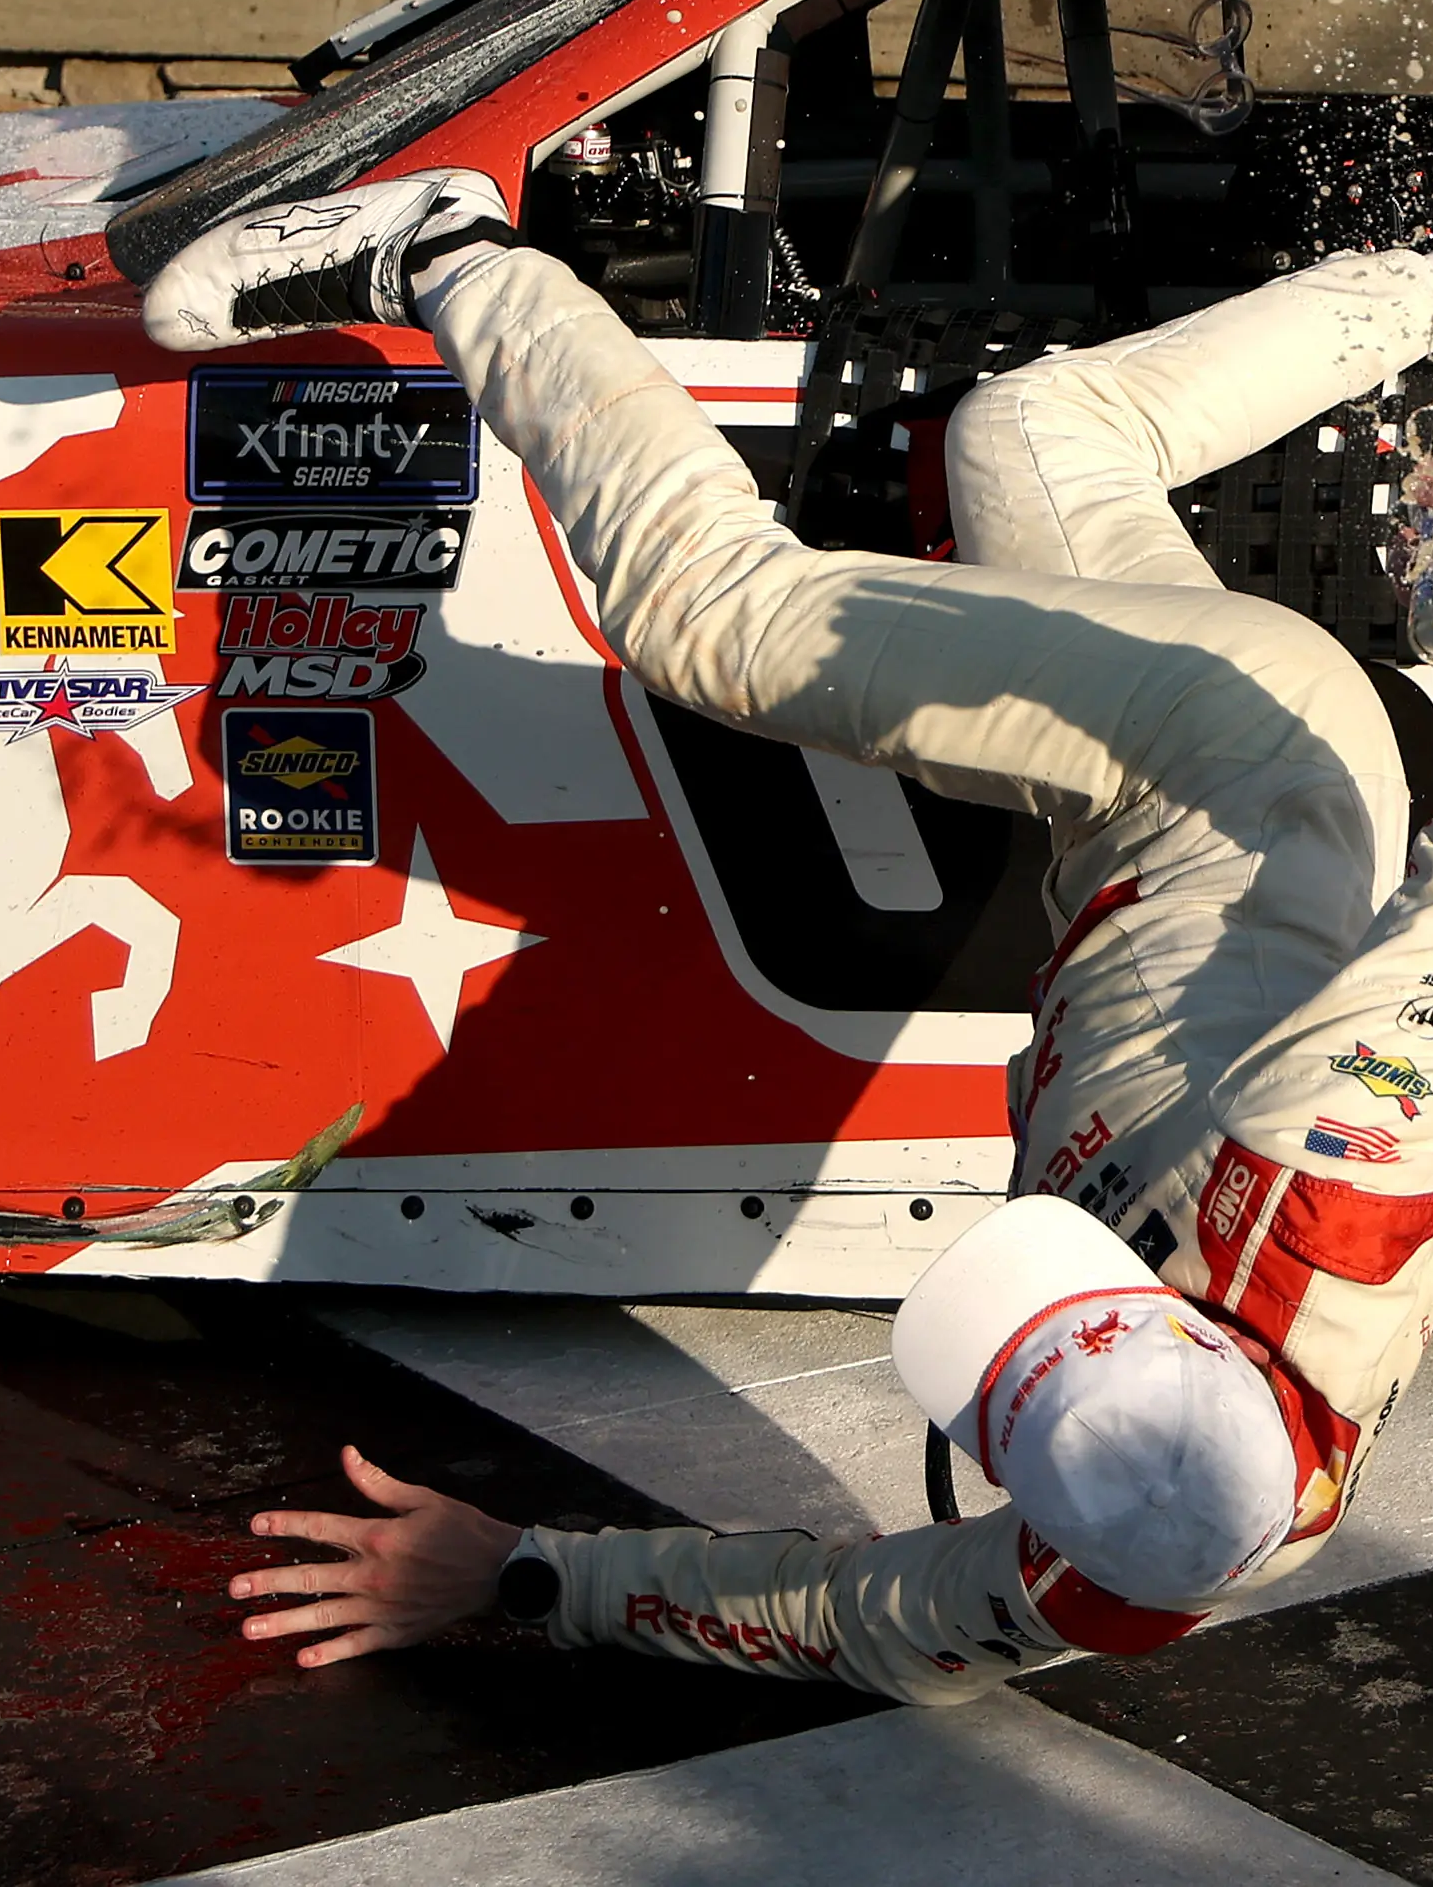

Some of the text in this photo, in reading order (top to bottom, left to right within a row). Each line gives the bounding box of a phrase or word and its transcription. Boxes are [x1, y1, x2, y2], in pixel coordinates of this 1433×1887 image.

[302, 381, 399, 405] NASCAR
[236, 409, 431, 474] xfinity
[291, 465, 371, 489] SERIES
[189, 514, 461, 575] COMETIC
[206, 574, 310, 587] GASKET
[4, 624, 169, 650] KENNAMETAL
[221, 596, 427, 662] Holley
[63, 676, 151, 702] STAR
[217, 654, 390, 698] MSD
[81, 705, 139, 718] Bodies
[243, 751, 356, 776] SUNOCO
[238, 807, 364, 832] ROOKIE
[244, 836, 362, 849] CONTENDER
[1335, 1052, 1429, 1099] SUNOCO
[1216, 1164, 1252, 1236] OMP
